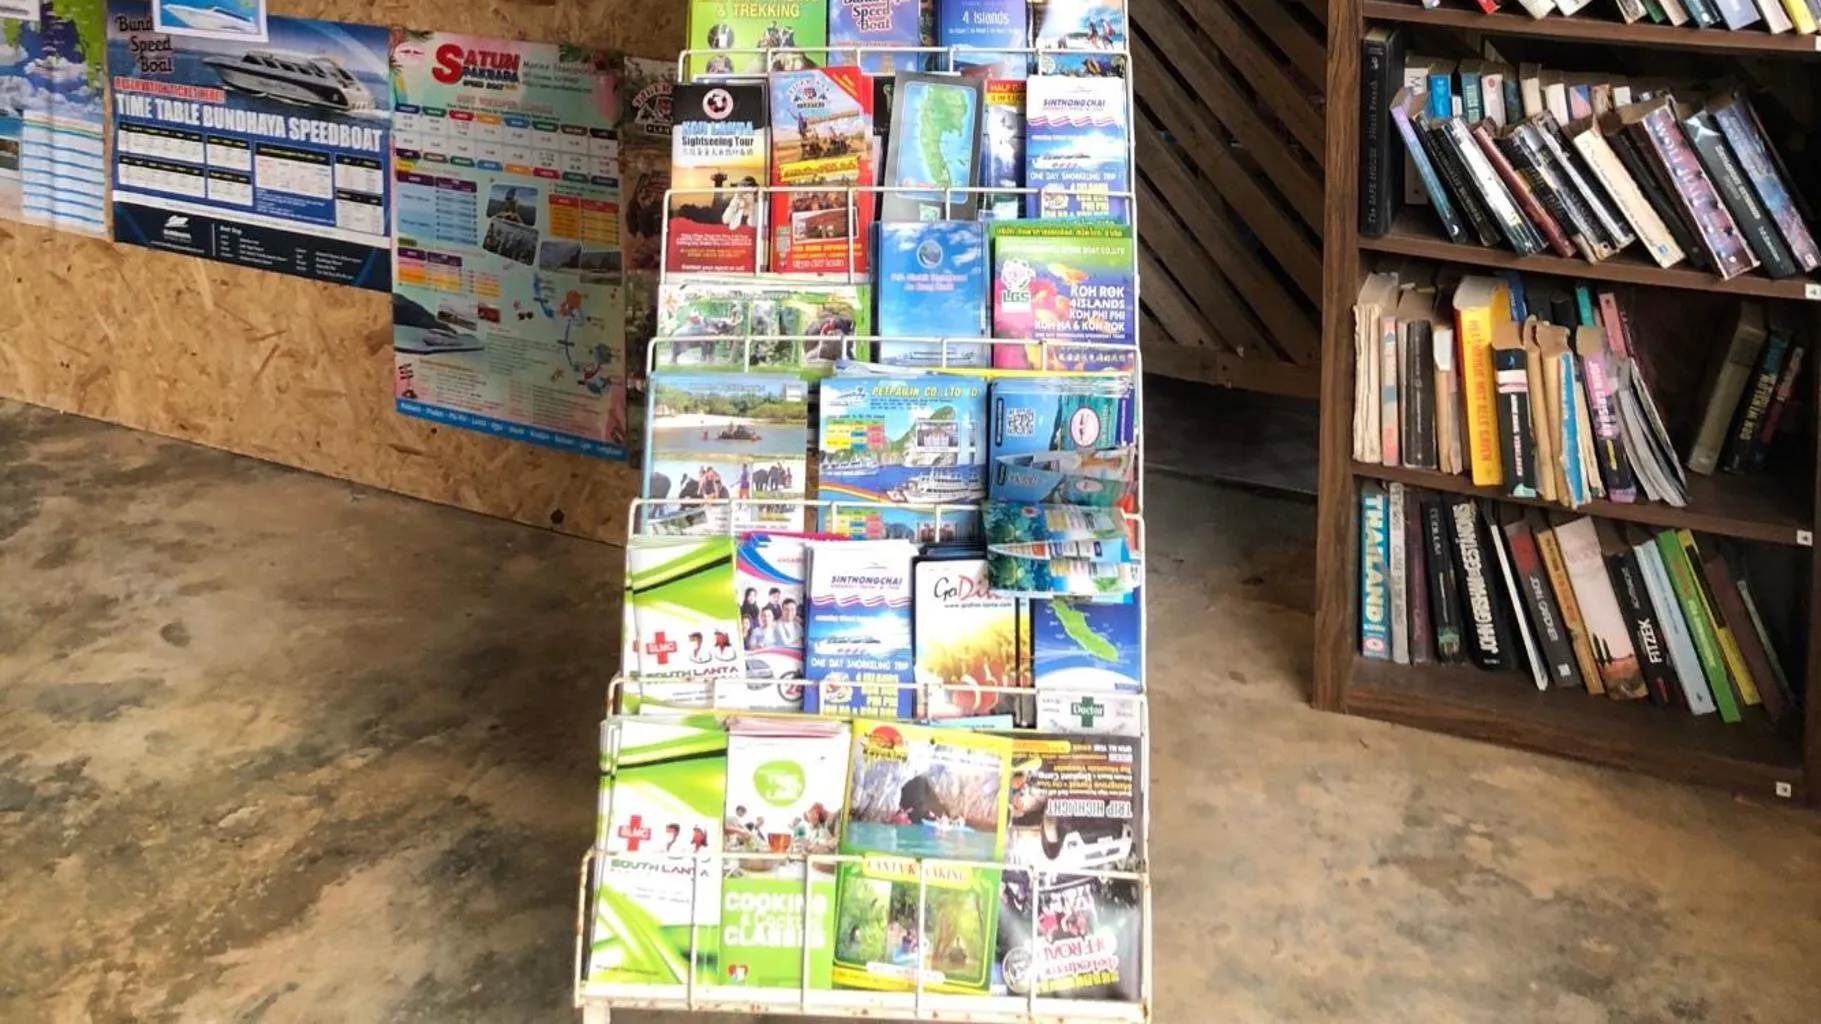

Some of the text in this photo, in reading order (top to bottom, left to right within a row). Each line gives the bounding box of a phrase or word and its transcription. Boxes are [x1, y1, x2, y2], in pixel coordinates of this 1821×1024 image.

[733, 3, 801, 18] TREKKING
[853, 6, 891, 23] Speed
[859, 19, 890, 31] Boat
[962, 11, 1011, 25] 4 Islands
[130, 35, 173, 53] Speed
[139, 56, 174, 73] Boat
[432, 43, 521, 85] SATUN
[115, 93, 153, 118] TIME
[154, 98, 200, 127] TABLE
[202, 109, 287, 141] BUNDHAYA
[288, 117, 384, 153] SPEEDBOAT
[682, 135, 755, 149] Sightseeing Tour
[1003, 292, 1030, 303] LGS
[1070, 286, 1125, 298] KOH ROK
[1069, 310, 1126, 320] KOH PHI PHI
[1034, 321, 1057, 330] KOH
[1081, 321, 1102, 331] KOH
[1103, 321, 1125, 332] ROK
[830, 574, 903, 586] SINTHONGCHAI
[1529, 575, 1544, 600] JOHN
[1638, 617, 1663, 664] FITZEK
[811, 658, 826, 668] ONE
[1072, 703, 1105, 717] Doctor
[1046, 799, 1134, 818] TRIP HIGHLIGHT
[610, 858, 709, 877] SOUTH LANTA
